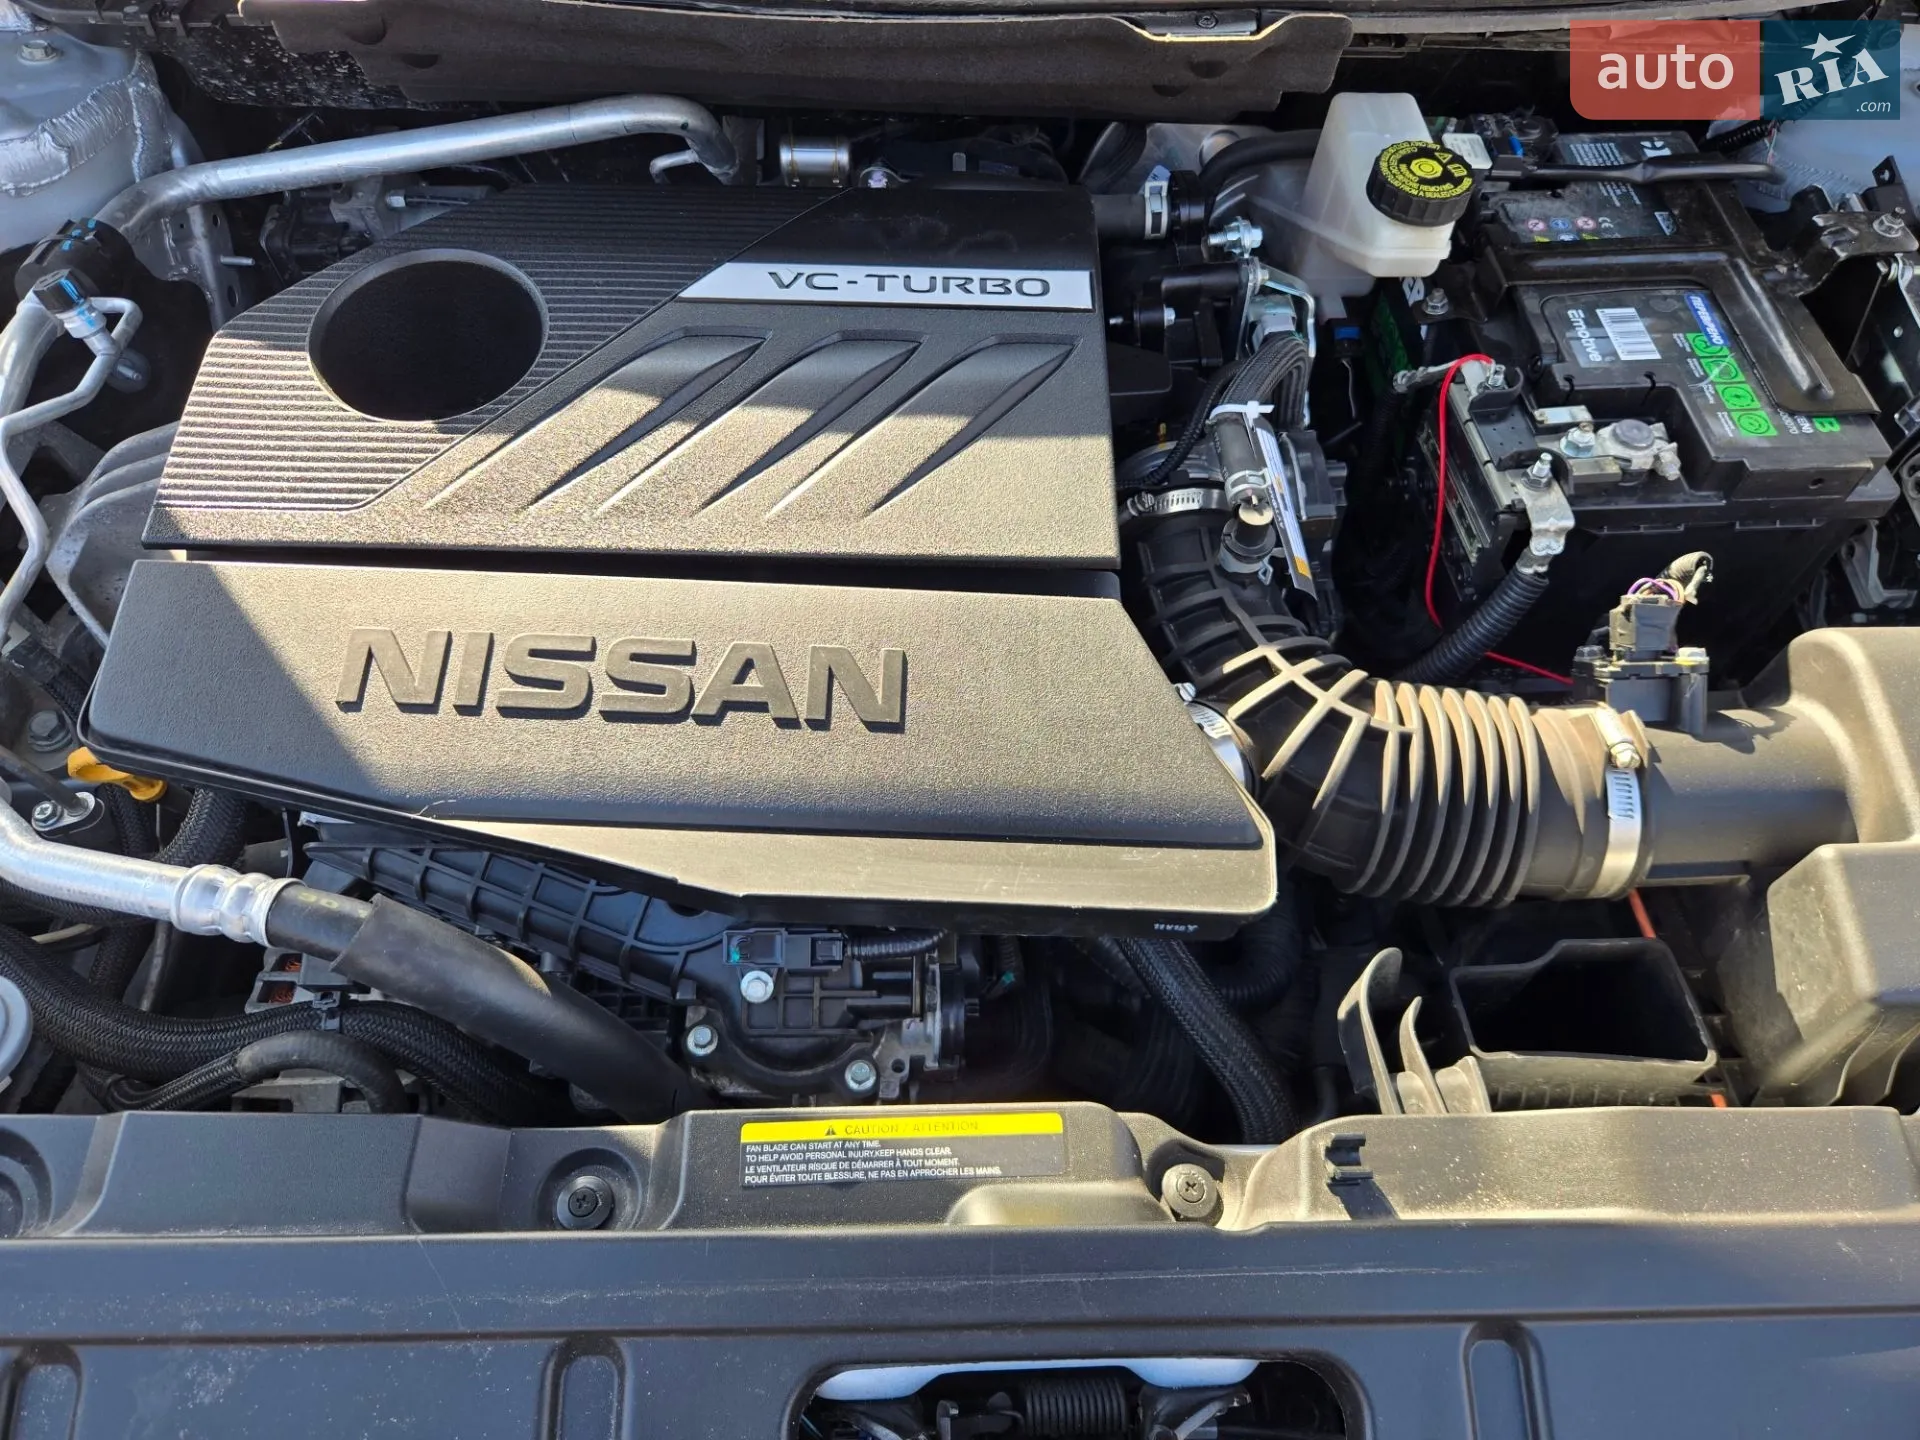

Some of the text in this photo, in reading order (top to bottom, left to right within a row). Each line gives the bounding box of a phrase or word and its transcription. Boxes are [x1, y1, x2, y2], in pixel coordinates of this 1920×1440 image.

[767, 271, 1051, 297] VC-TURBO
[336, 628, 908, 730] NISSAN
[844, 1124, 899, 1136] CAUTION
[913, 1121, 979, 1133] ATTENTION
[746, 1144, 761, 1153] FAN
[763, 1143, 788, 1152] BLADE
[790, 1142, 806, 1151] CAN
[808, 1141, 832, 1150] START
[834, 1140, 843, 1149] AT
[844, 1140, 860, 1149] ANY
[745, 1154, 757, 1163] TO
[758, 1153, 779, 1162] HELP
[780, 1152, 804, 1161] AVOID
[805, 1150, 847, 1160] PERSONAL
[896, 1147, 923, 1157] HANDS
[745, 1165, 755, 1174] LE
[756, 1163, 807, 1173] VENTILATEUR
[839, 1161, 850, 1170] DE
[851, 1158, 894, 1169] DÉMARRER
[903, 1158, 923, 1168] TOUT
[744, 1174, 768, 1184] POUR
[769, 1172, 796, 1183] ÉVITER
[797, 1172, 823, 1182] TOUTE
[824, 1170, 867, 1181] BLESSURE,
[868, 1170, 880, 1179] NE
[881, 1169, 896, 1179] PAS
[898, 1169, 909, 1178] EN
[909, 1167, 959, 1178] APPROCHER
[959, 1166, 975, 1176] LES
